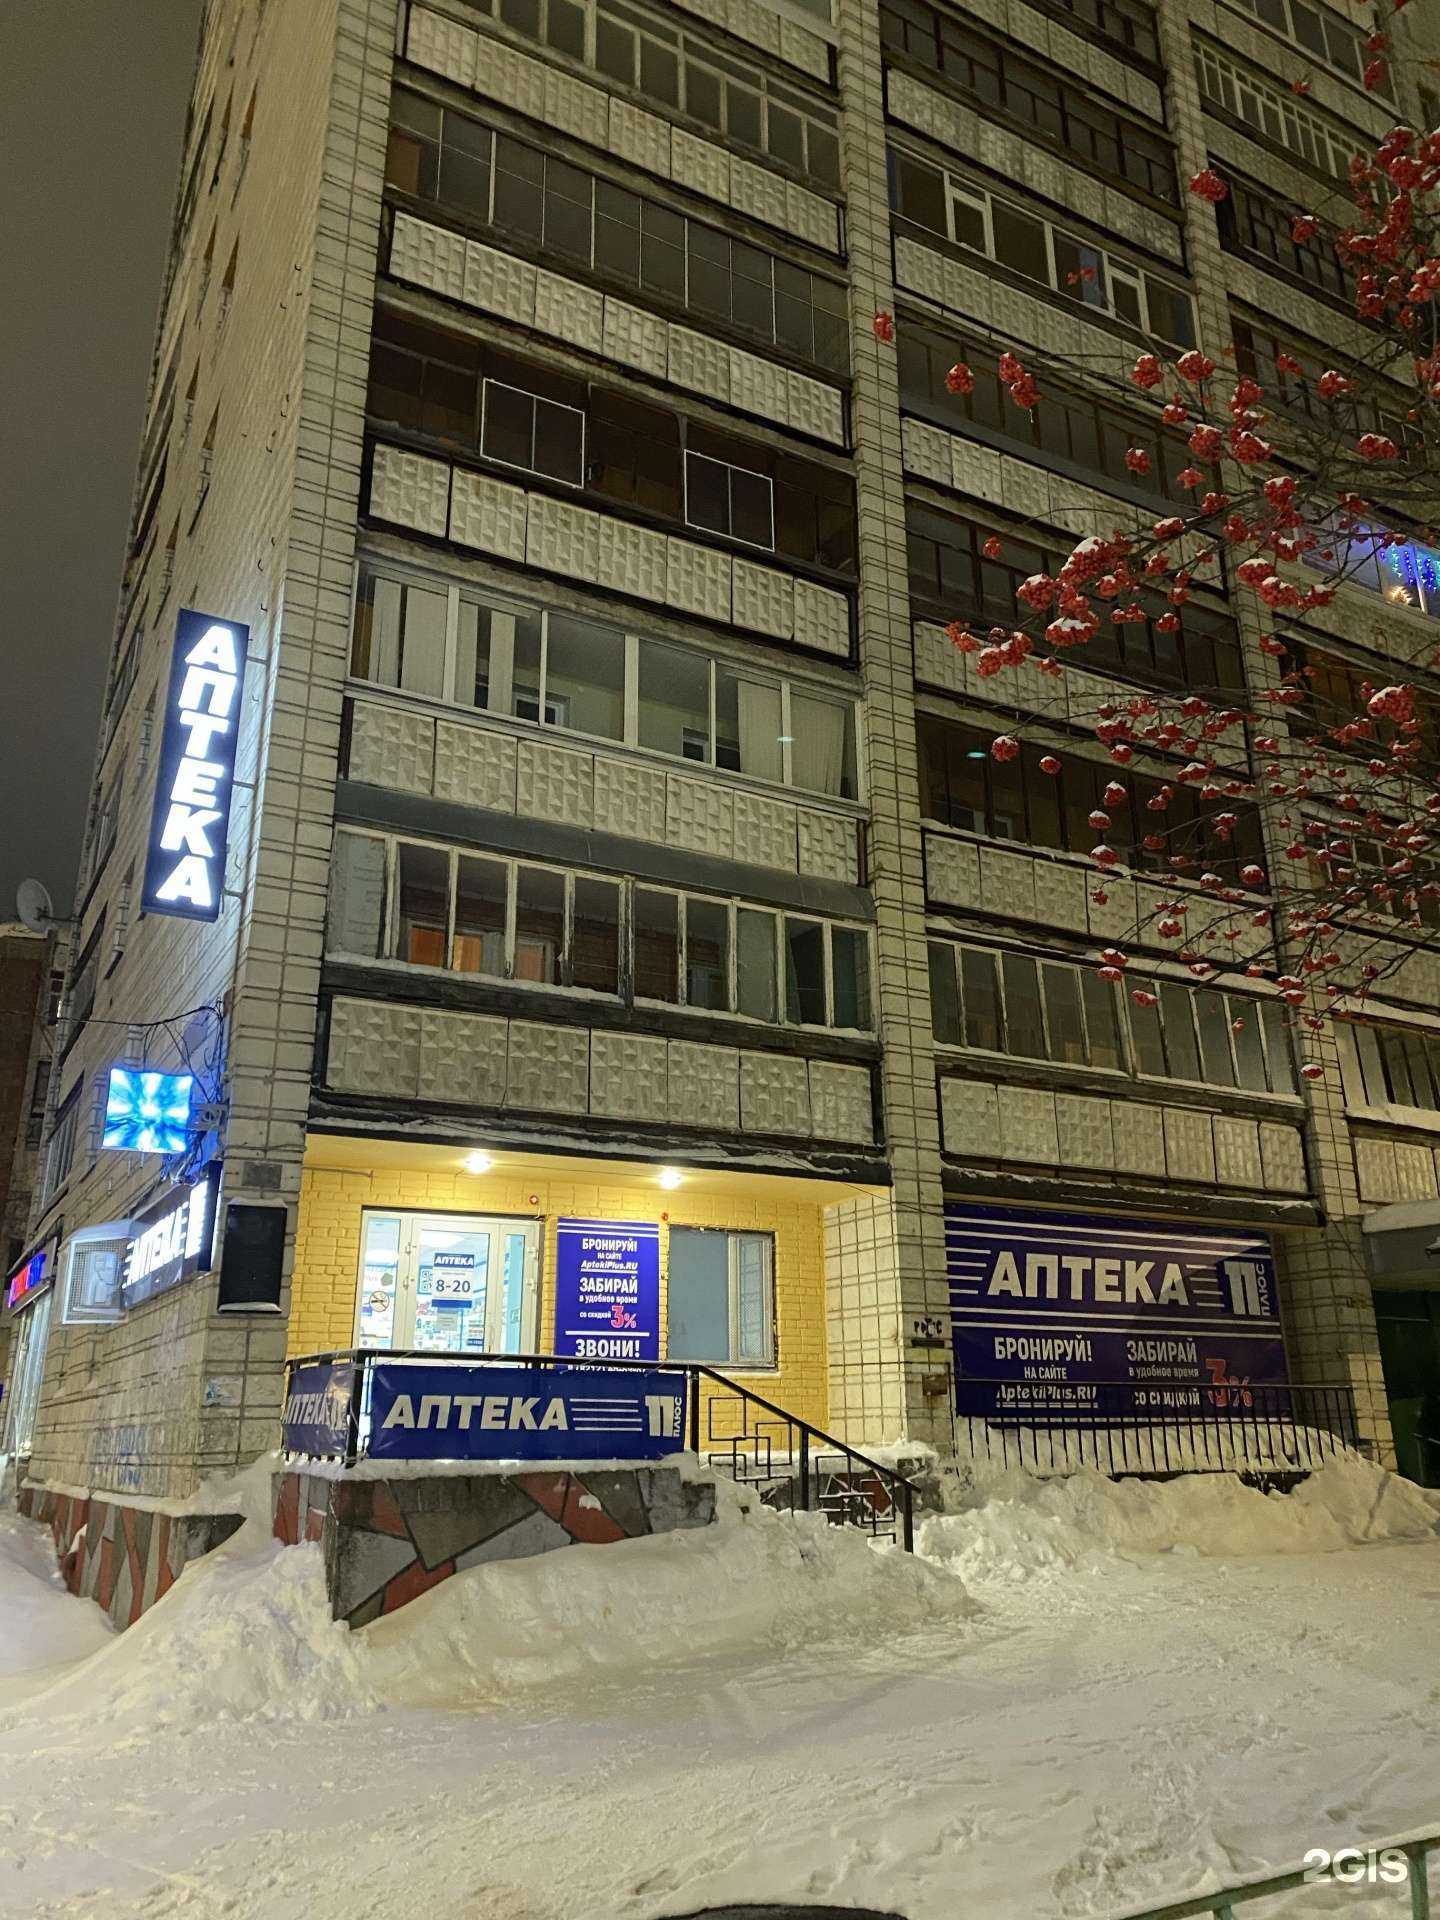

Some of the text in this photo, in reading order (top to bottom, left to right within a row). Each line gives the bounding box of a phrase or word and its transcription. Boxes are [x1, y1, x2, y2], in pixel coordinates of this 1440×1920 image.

[156, 626, 237, 907] АПТЕКА
[582, 1238, 637, 1252] БРОНИРУЙ!
[435, 1256, 473, 1266] АПТЕКА
[436, 1279, 470, 1293] 8-20
[579, 1276, 638, 1294] ЗАБИРАЙ
[987, 1251, 1189, 1305] АПТЕКА
[1256, 1263, 1270, 1316] ПЛЮС
[610, 1305, 637, 1328] 3%
[575, 1339, 640, 1357] ЗВОНИ!
[995, 1334, 1197, 1363] БРОНИРУЙ! ЗАБИРАЙ
[1024, 1364, 1068, 1380] НА САЙТЕ
[1128, 1365, 1199, 1379] в удобное время
[382, 1395, 568, 1431] АПТЕКА
[673, 1396, 682, 1437] ПЛЮС
